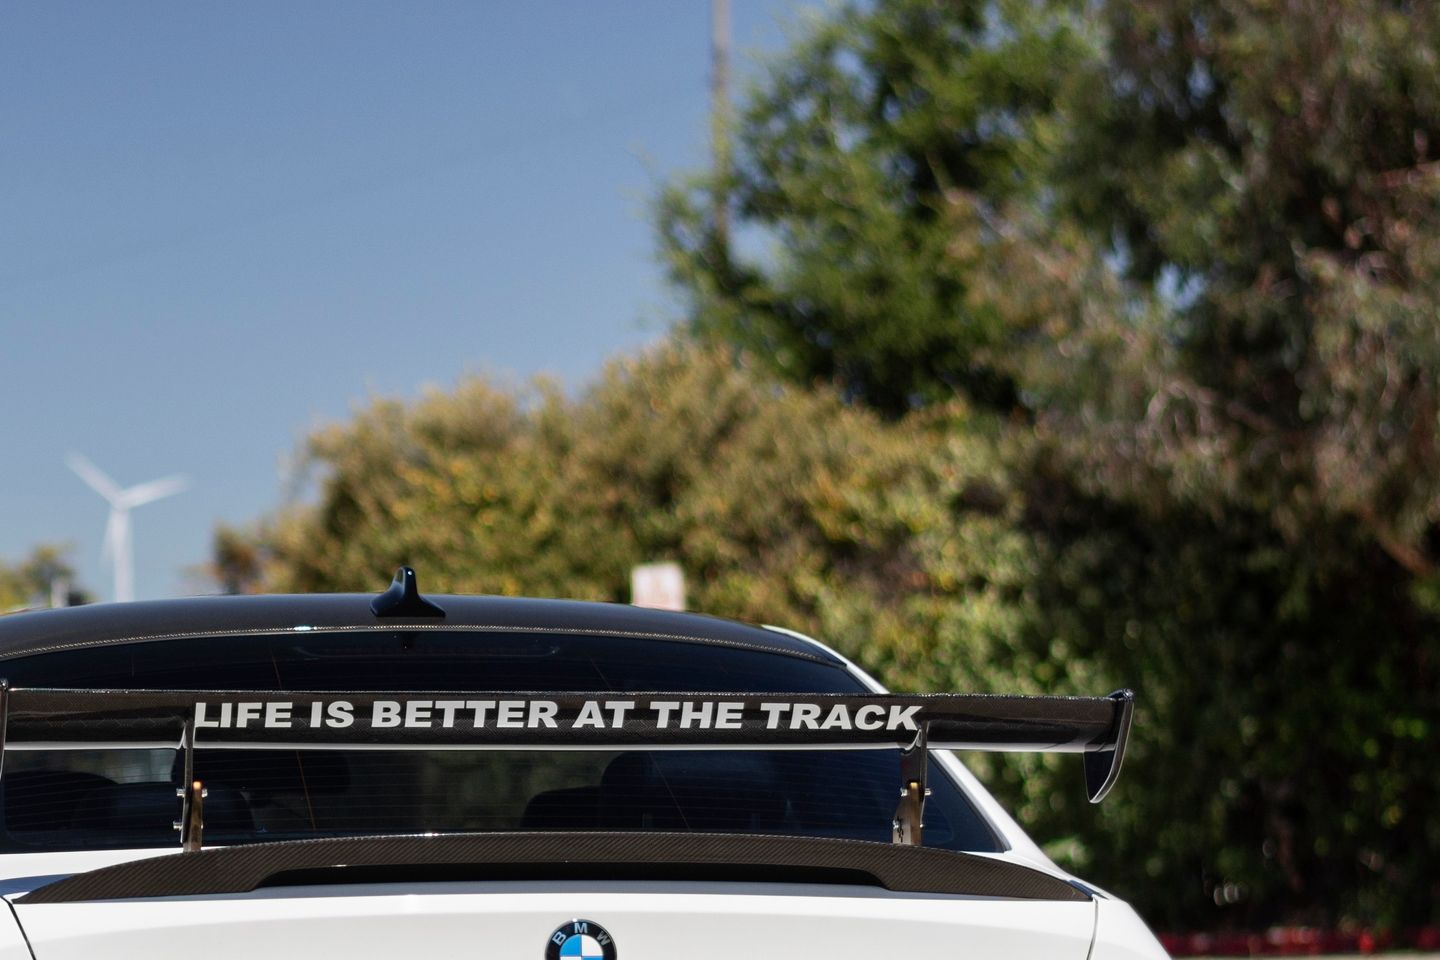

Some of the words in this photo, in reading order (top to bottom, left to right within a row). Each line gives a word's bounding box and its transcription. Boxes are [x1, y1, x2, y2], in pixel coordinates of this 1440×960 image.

[194, 701, 293, 728] LIFE
[310, 701, 355, 728] IS
[371, 700, 559, 728] BETTER
[572, 701, 635, 728] AT
[650, 702, 744, 729] THE
[760, 703, 923, 730] TRACK
[552, 922, 610, 946] BMW
